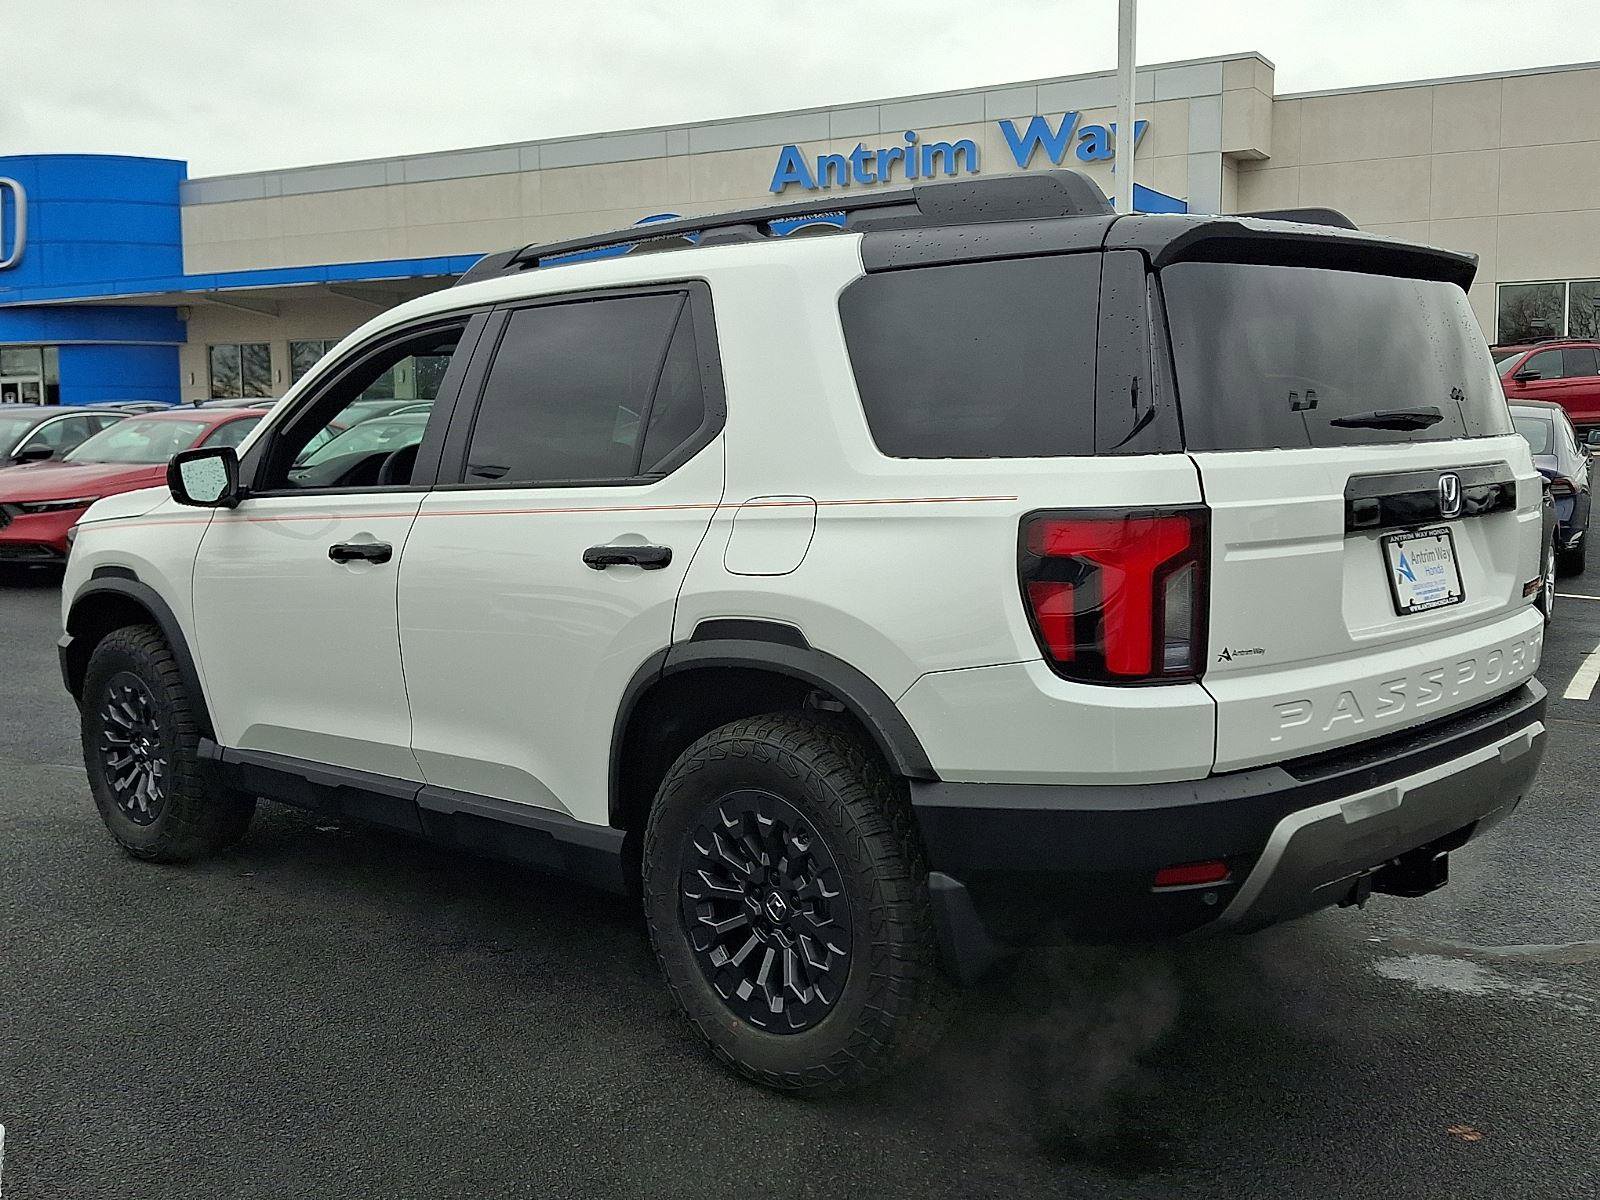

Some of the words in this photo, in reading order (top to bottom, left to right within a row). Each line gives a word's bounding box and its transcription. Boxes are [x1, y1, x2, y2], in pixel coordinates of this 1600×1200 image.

[768, 129, 982, 194] Antrim
[1390, 532, 1414, 542] ANTRIM
[1428, 528, 1450, 536] HONDA
[1411, 548, 1436, 565] Antrim
[1435, 546, 1451, 563] Way
[1425, 565, 1444, 575] Honda
[1270, 631, 1541, 742] PASSPORT
